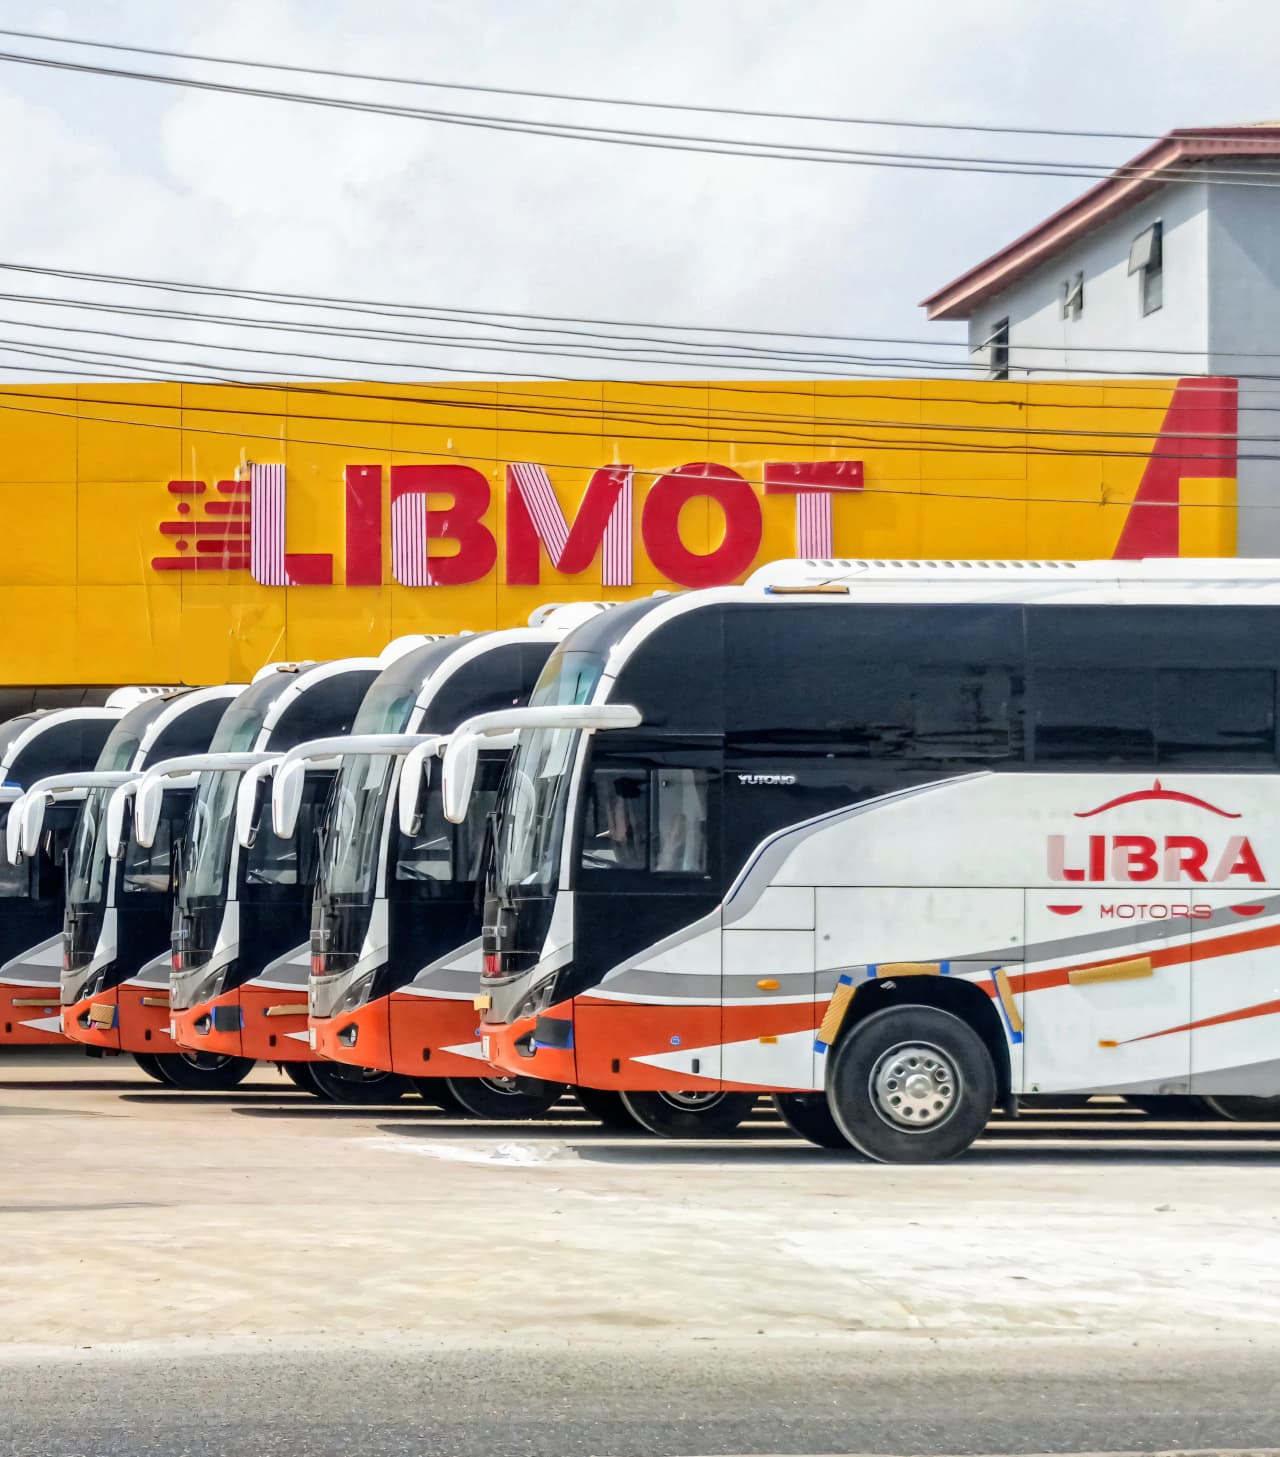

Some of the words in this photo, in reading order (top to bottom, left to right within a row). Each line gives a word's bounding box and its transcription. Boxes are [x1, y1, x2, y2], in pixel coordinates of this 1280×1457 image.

[250, 461, 864, 587] LIBMOT
[738, 774, 796, 785] YUTONG
[1047, 835, 1266, 882] LIBRA
[1100, 904, 1213, 919] MOTORS
